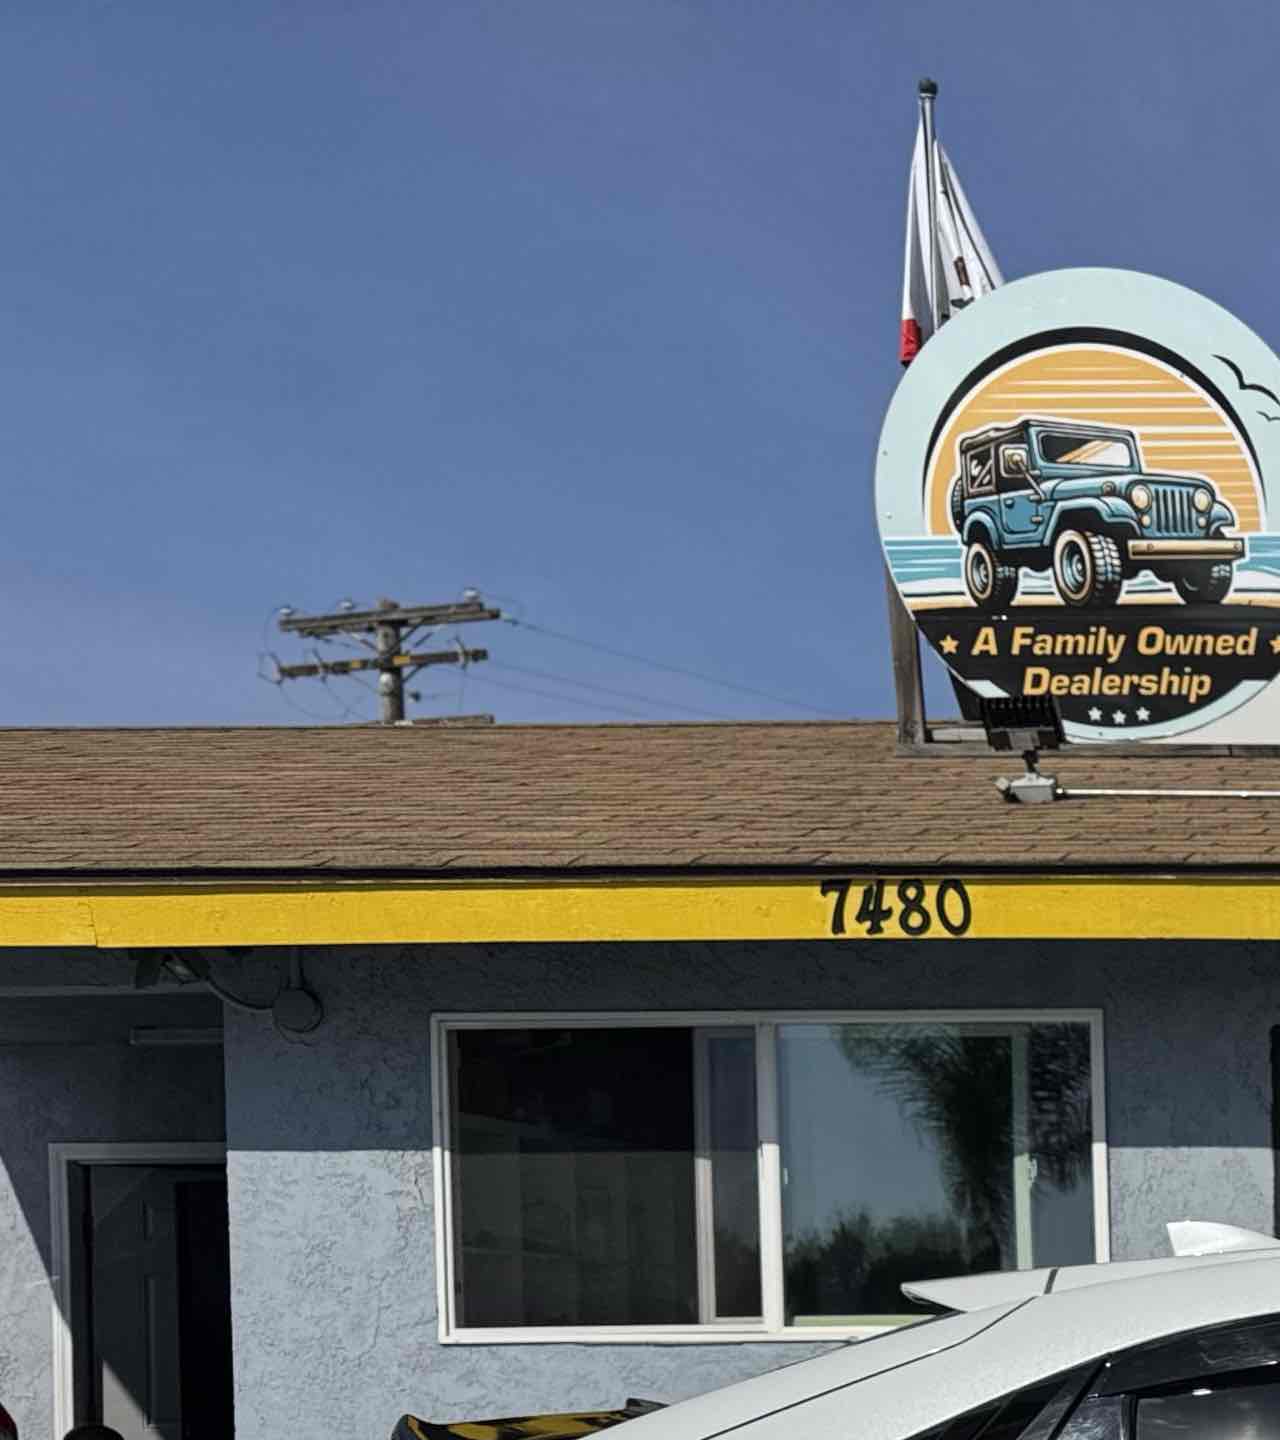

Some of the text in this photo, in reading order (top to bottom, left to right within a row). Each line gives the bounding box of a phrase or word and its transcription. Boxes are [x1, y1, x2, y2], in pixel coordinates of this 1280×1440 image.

[971, 626, 1258, 663] A Family Owned
[1023, 667, 1211, 703] Dealership
[820, 878, 972, 936] 7480
